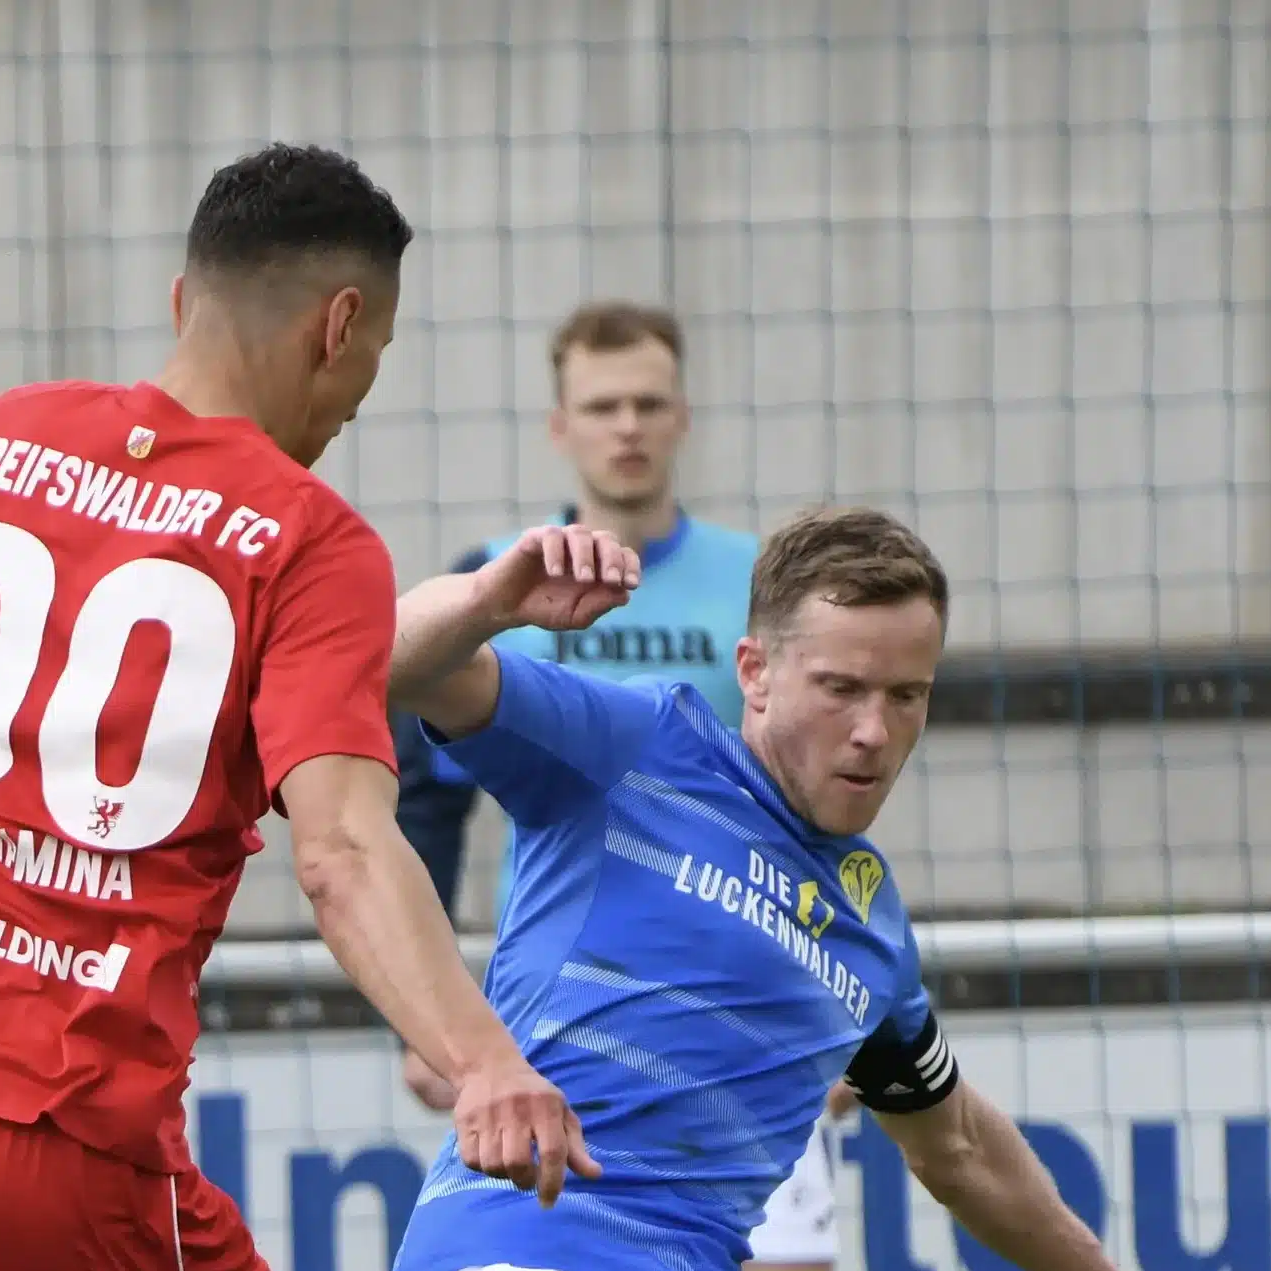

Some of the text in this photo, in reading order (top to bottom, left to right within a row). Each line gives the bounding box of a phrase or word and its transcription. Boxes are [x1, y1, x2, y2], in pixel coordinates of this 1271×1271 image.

[215, 504, 281, 556] FC
[749, 848, 792, 908] DIE
[674, 854, 870, 1026] LUCKENWALDER
